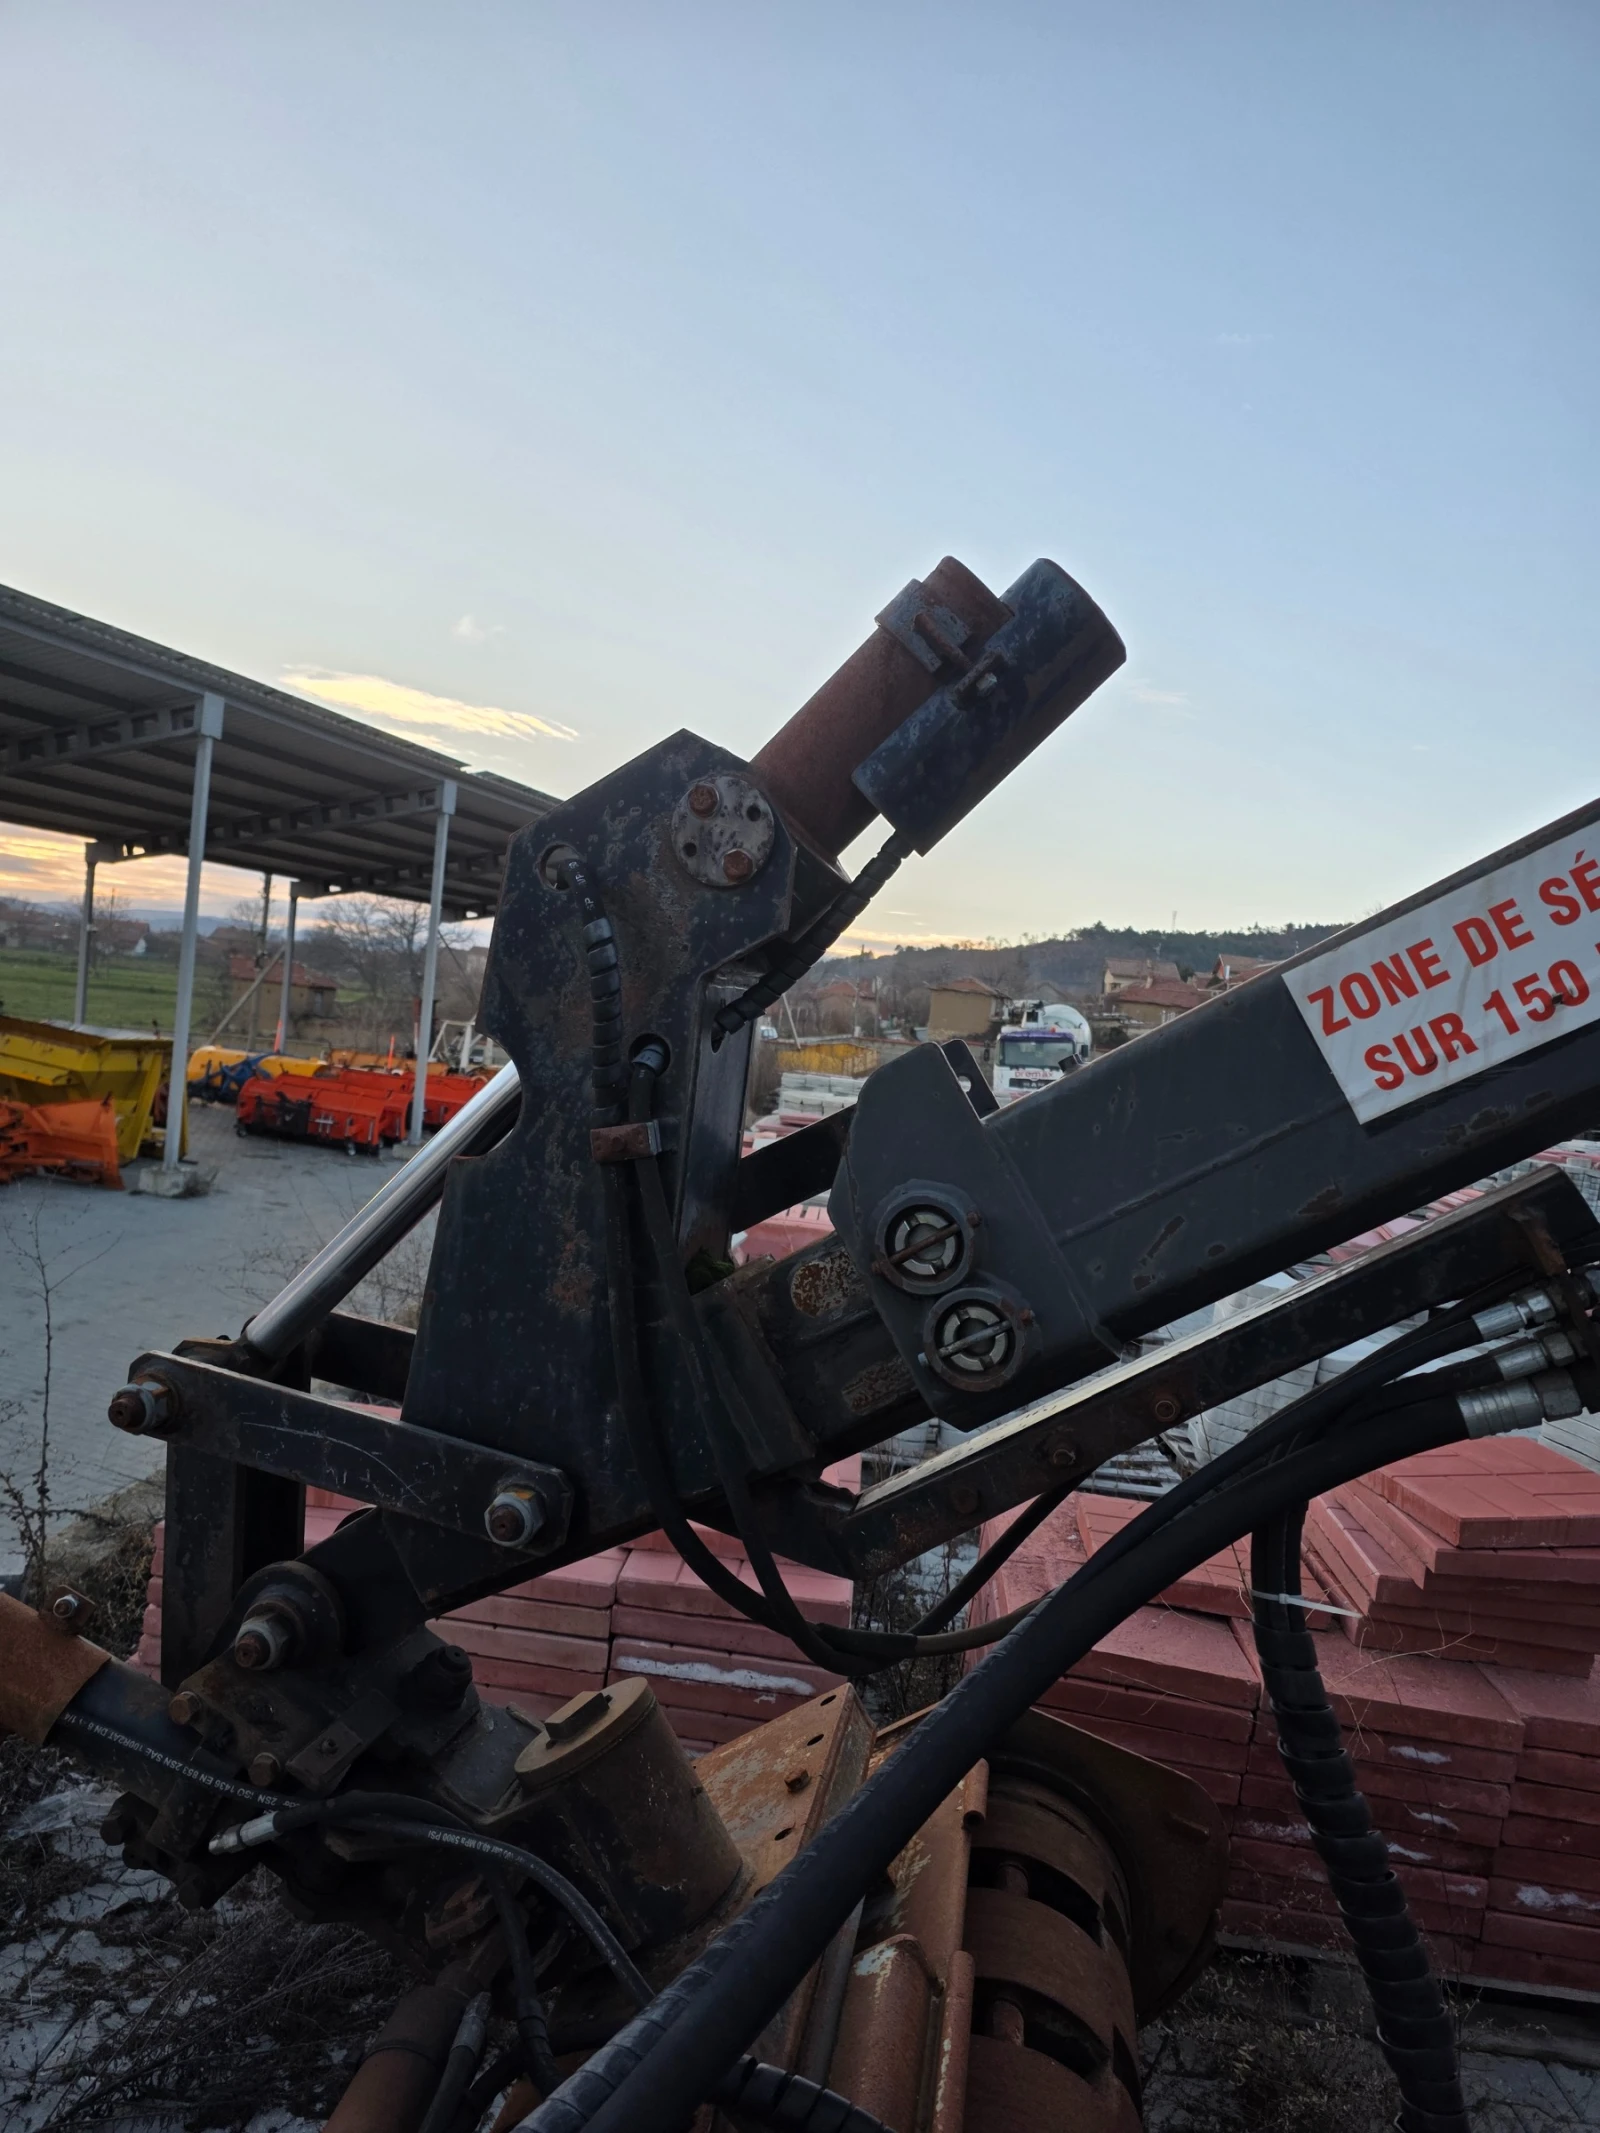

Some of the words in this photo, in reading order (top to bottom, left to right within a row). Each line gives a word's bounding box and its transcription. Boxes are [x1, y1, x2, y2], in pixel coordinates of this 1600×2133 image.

[1307, 938, 1451, 1037] ZONE
[1452, 898, 1535, 967] DE
[1364, 1012, 1479, 1091] SUR
[1482, 959, 1590, 1036] 150
[145, 1748, 163, 1762] SAE
[163, 1757, 183, 1771] 2SN
[182, 1766, 199, 1779] 853
[199, 1774, 214, 1785] EN
[214, 1780, 235, 1793] 1436
[258, 1794, 278, 1806] 2SN
